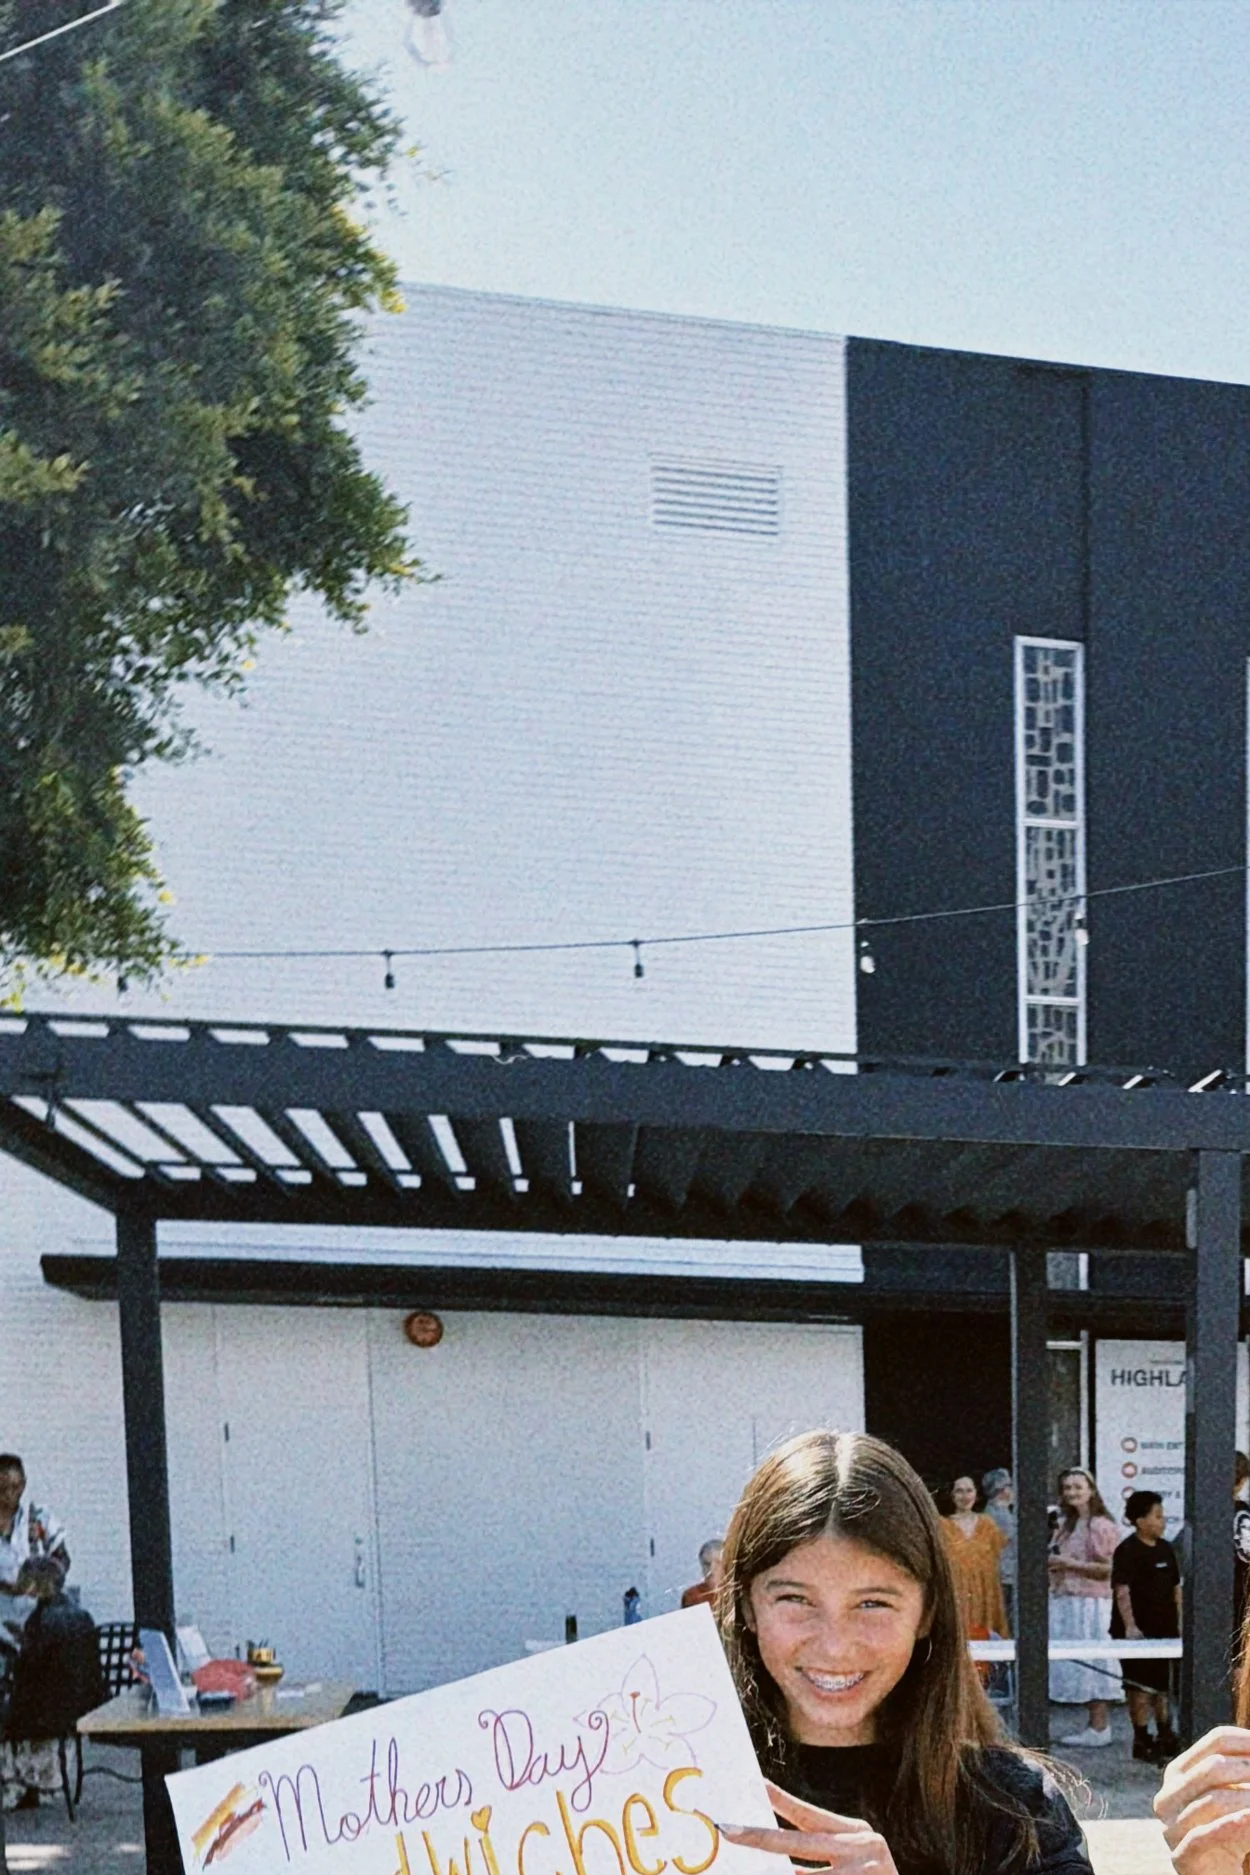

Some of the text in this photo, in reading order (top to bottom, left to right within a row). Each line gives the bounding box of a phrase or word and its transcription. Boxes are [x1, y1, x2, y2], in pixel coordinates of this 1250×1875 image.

[1111, 1368, 1186, 1387] HIGHLA
[258, 1709, 609, 1861] Mothers Day
